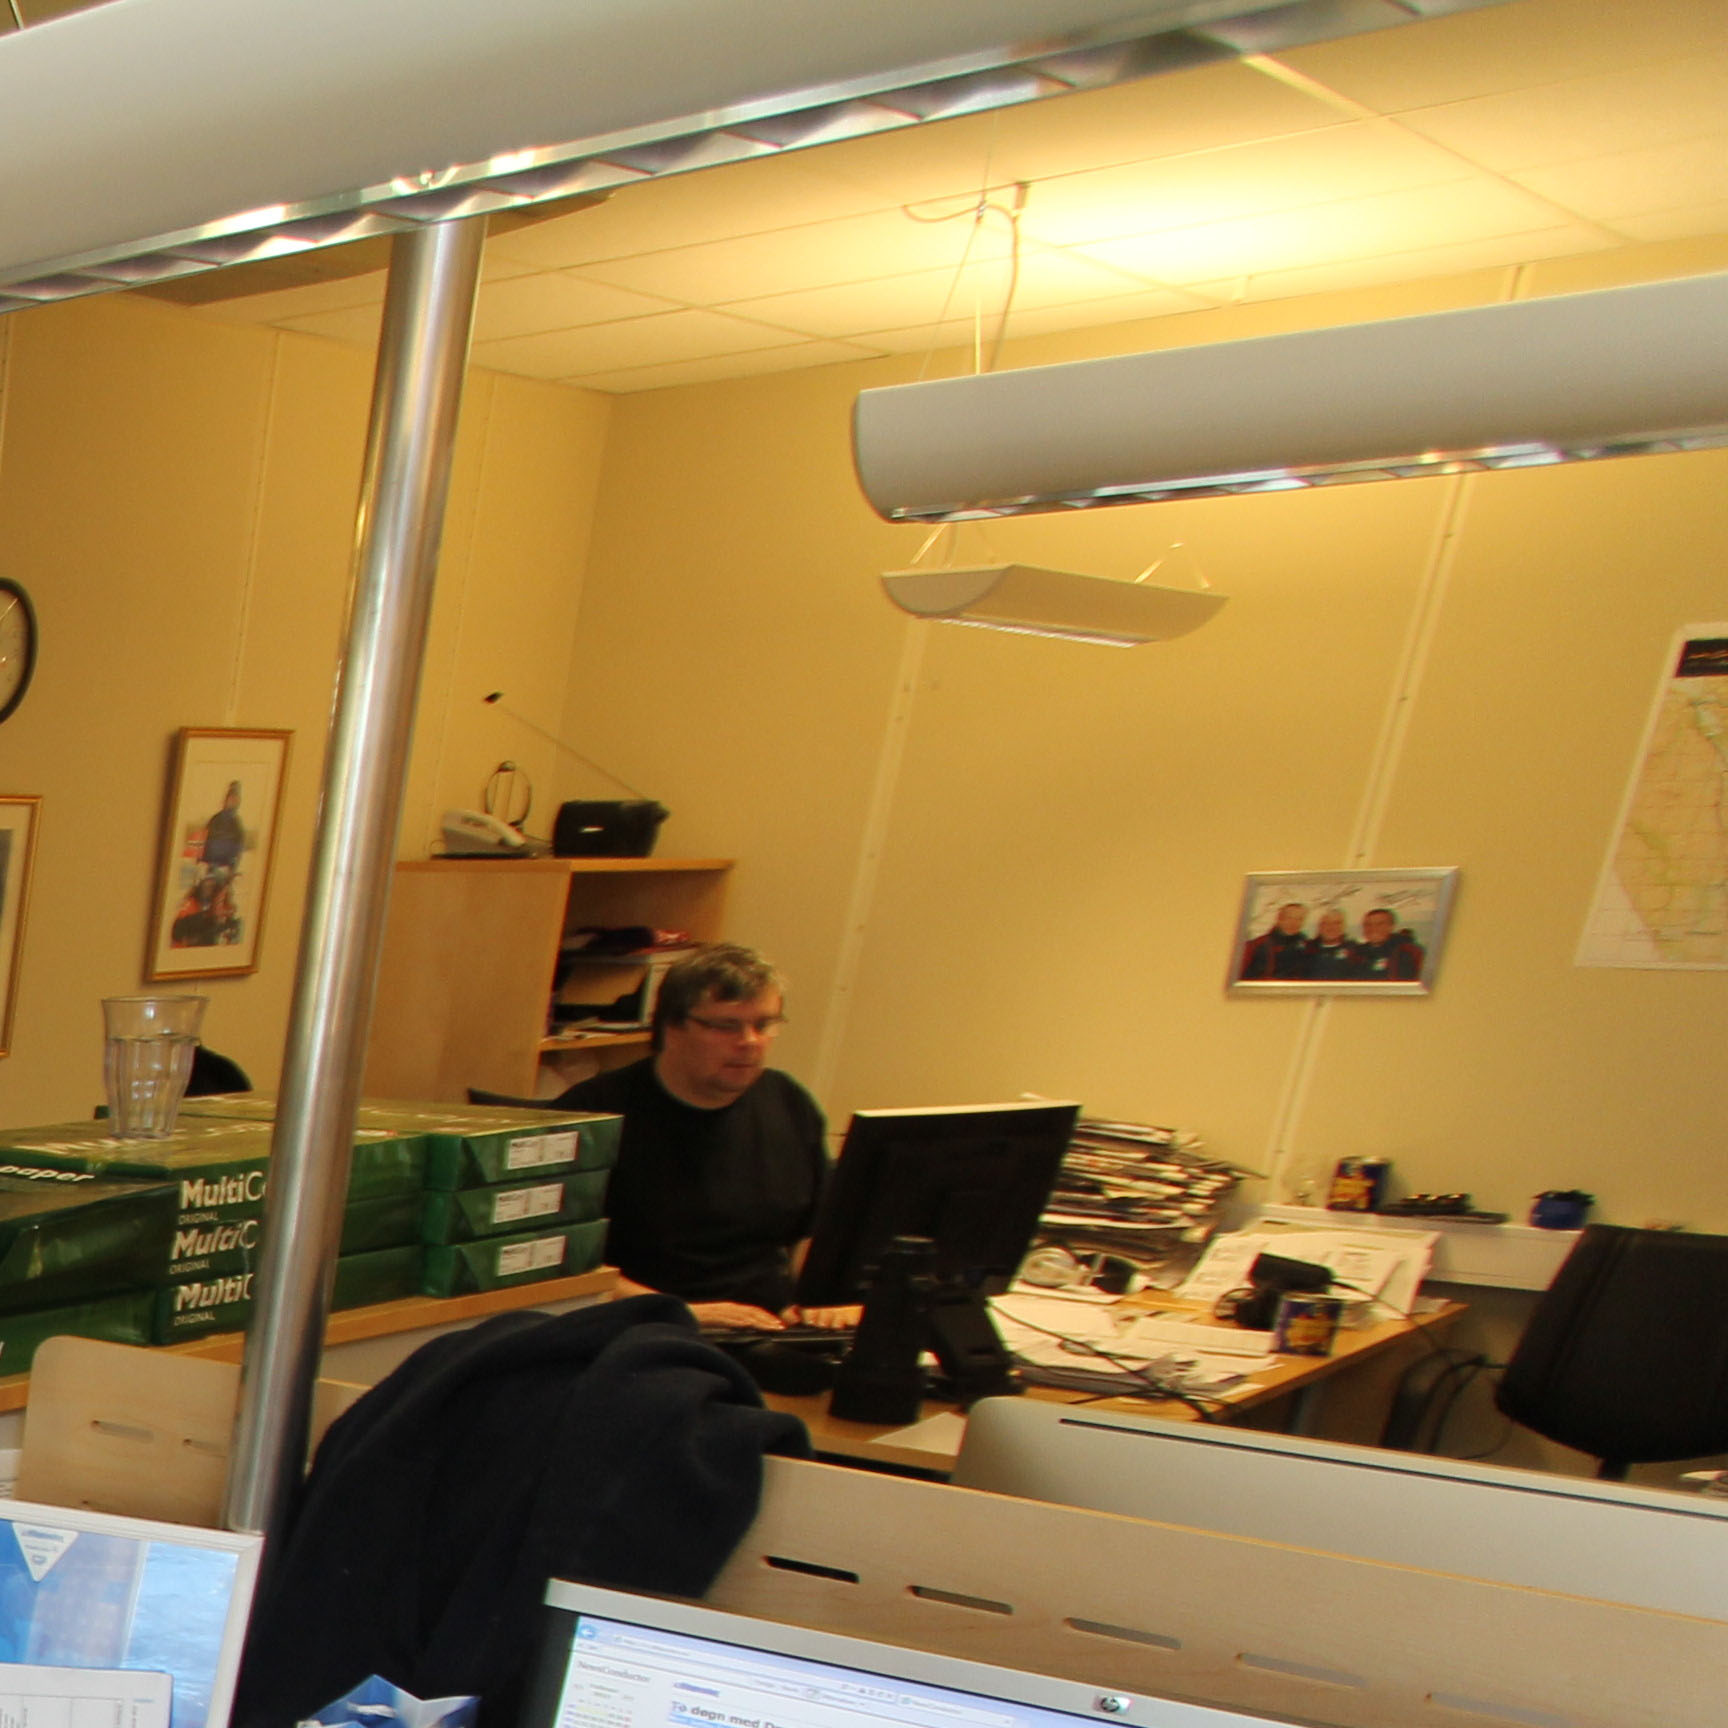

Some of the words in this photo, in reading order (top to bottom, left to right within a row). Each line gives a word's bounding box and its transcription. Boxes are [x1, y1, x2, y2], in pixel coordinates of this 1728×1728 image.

[180, 1171, 267, 1209] MultiC
[171, 1220, 258, 1260] MultiC
[169, 1260, 209, 1274] ORIGINAL
[174, 1312, 215, 1326] ORIGINAL
[690, 1705, 726, 1723] døgn
[730, 1714, 761, 1728] med
